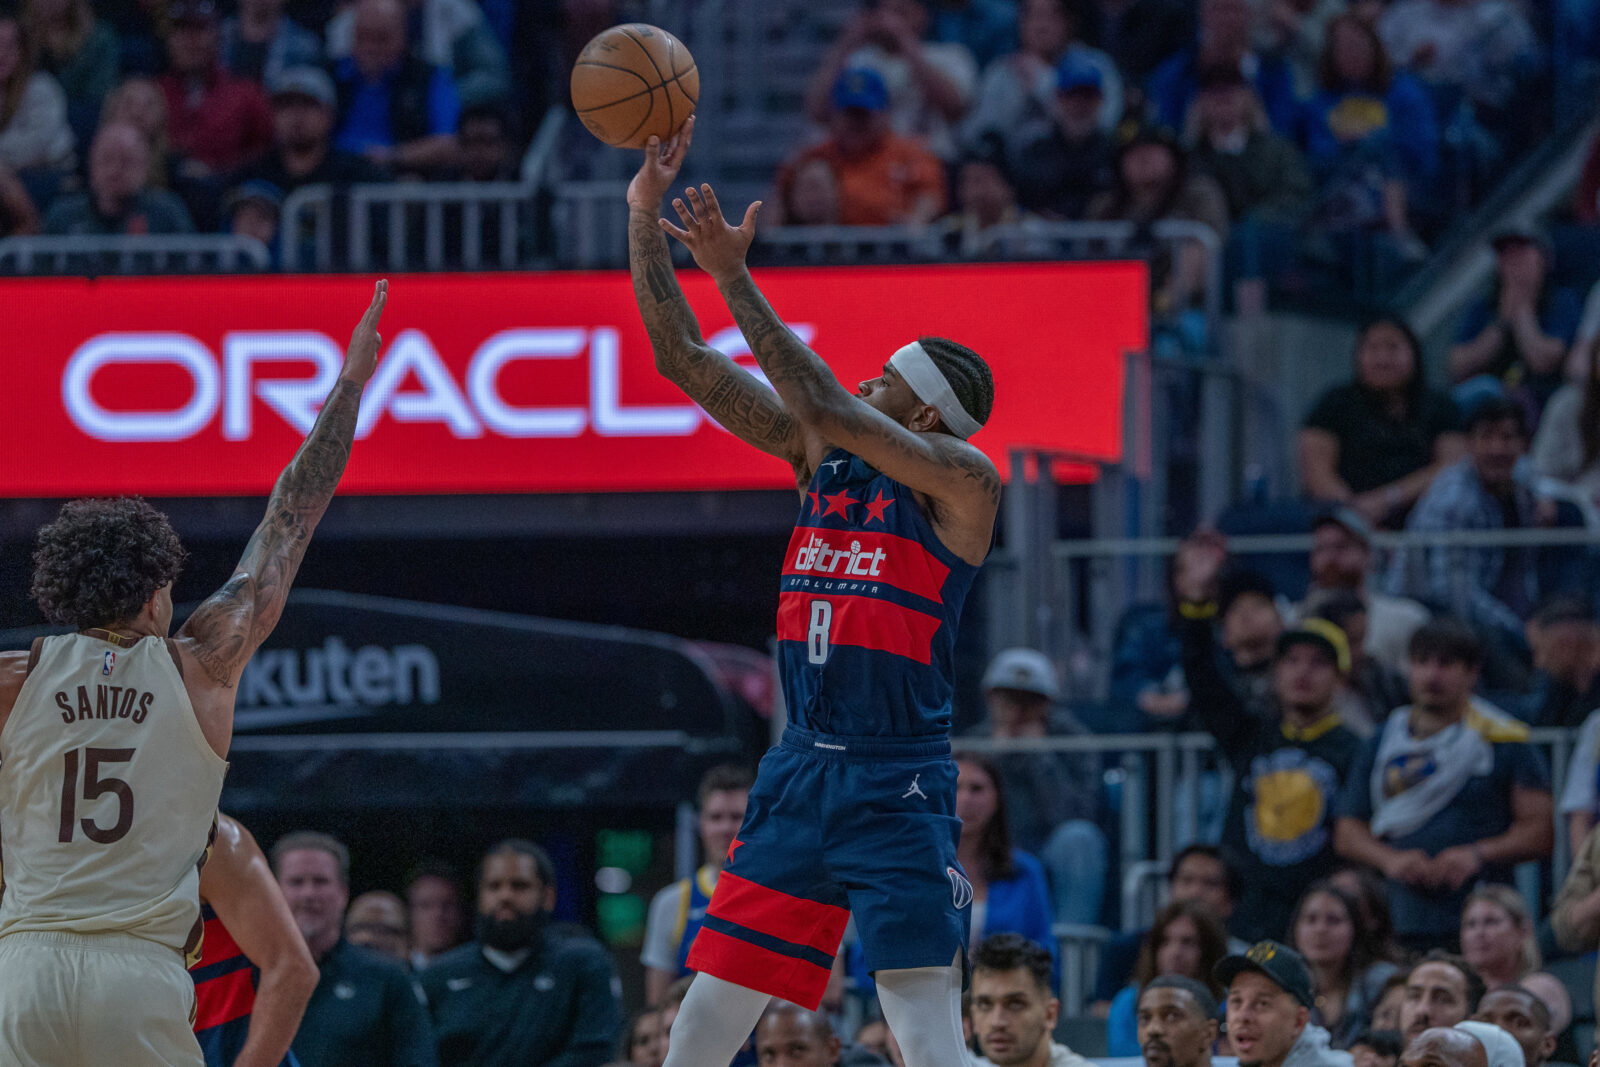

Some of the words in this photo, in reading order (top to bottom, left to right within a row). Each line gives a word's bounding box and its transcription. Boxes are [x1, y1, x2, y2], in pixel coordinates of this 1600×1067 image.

[808, 600, 832, 665] 8
[237, 635, 439, 704] kuten
[55, 684, 154, 724] SANTOS
[58, 747, 136, 844] 15
